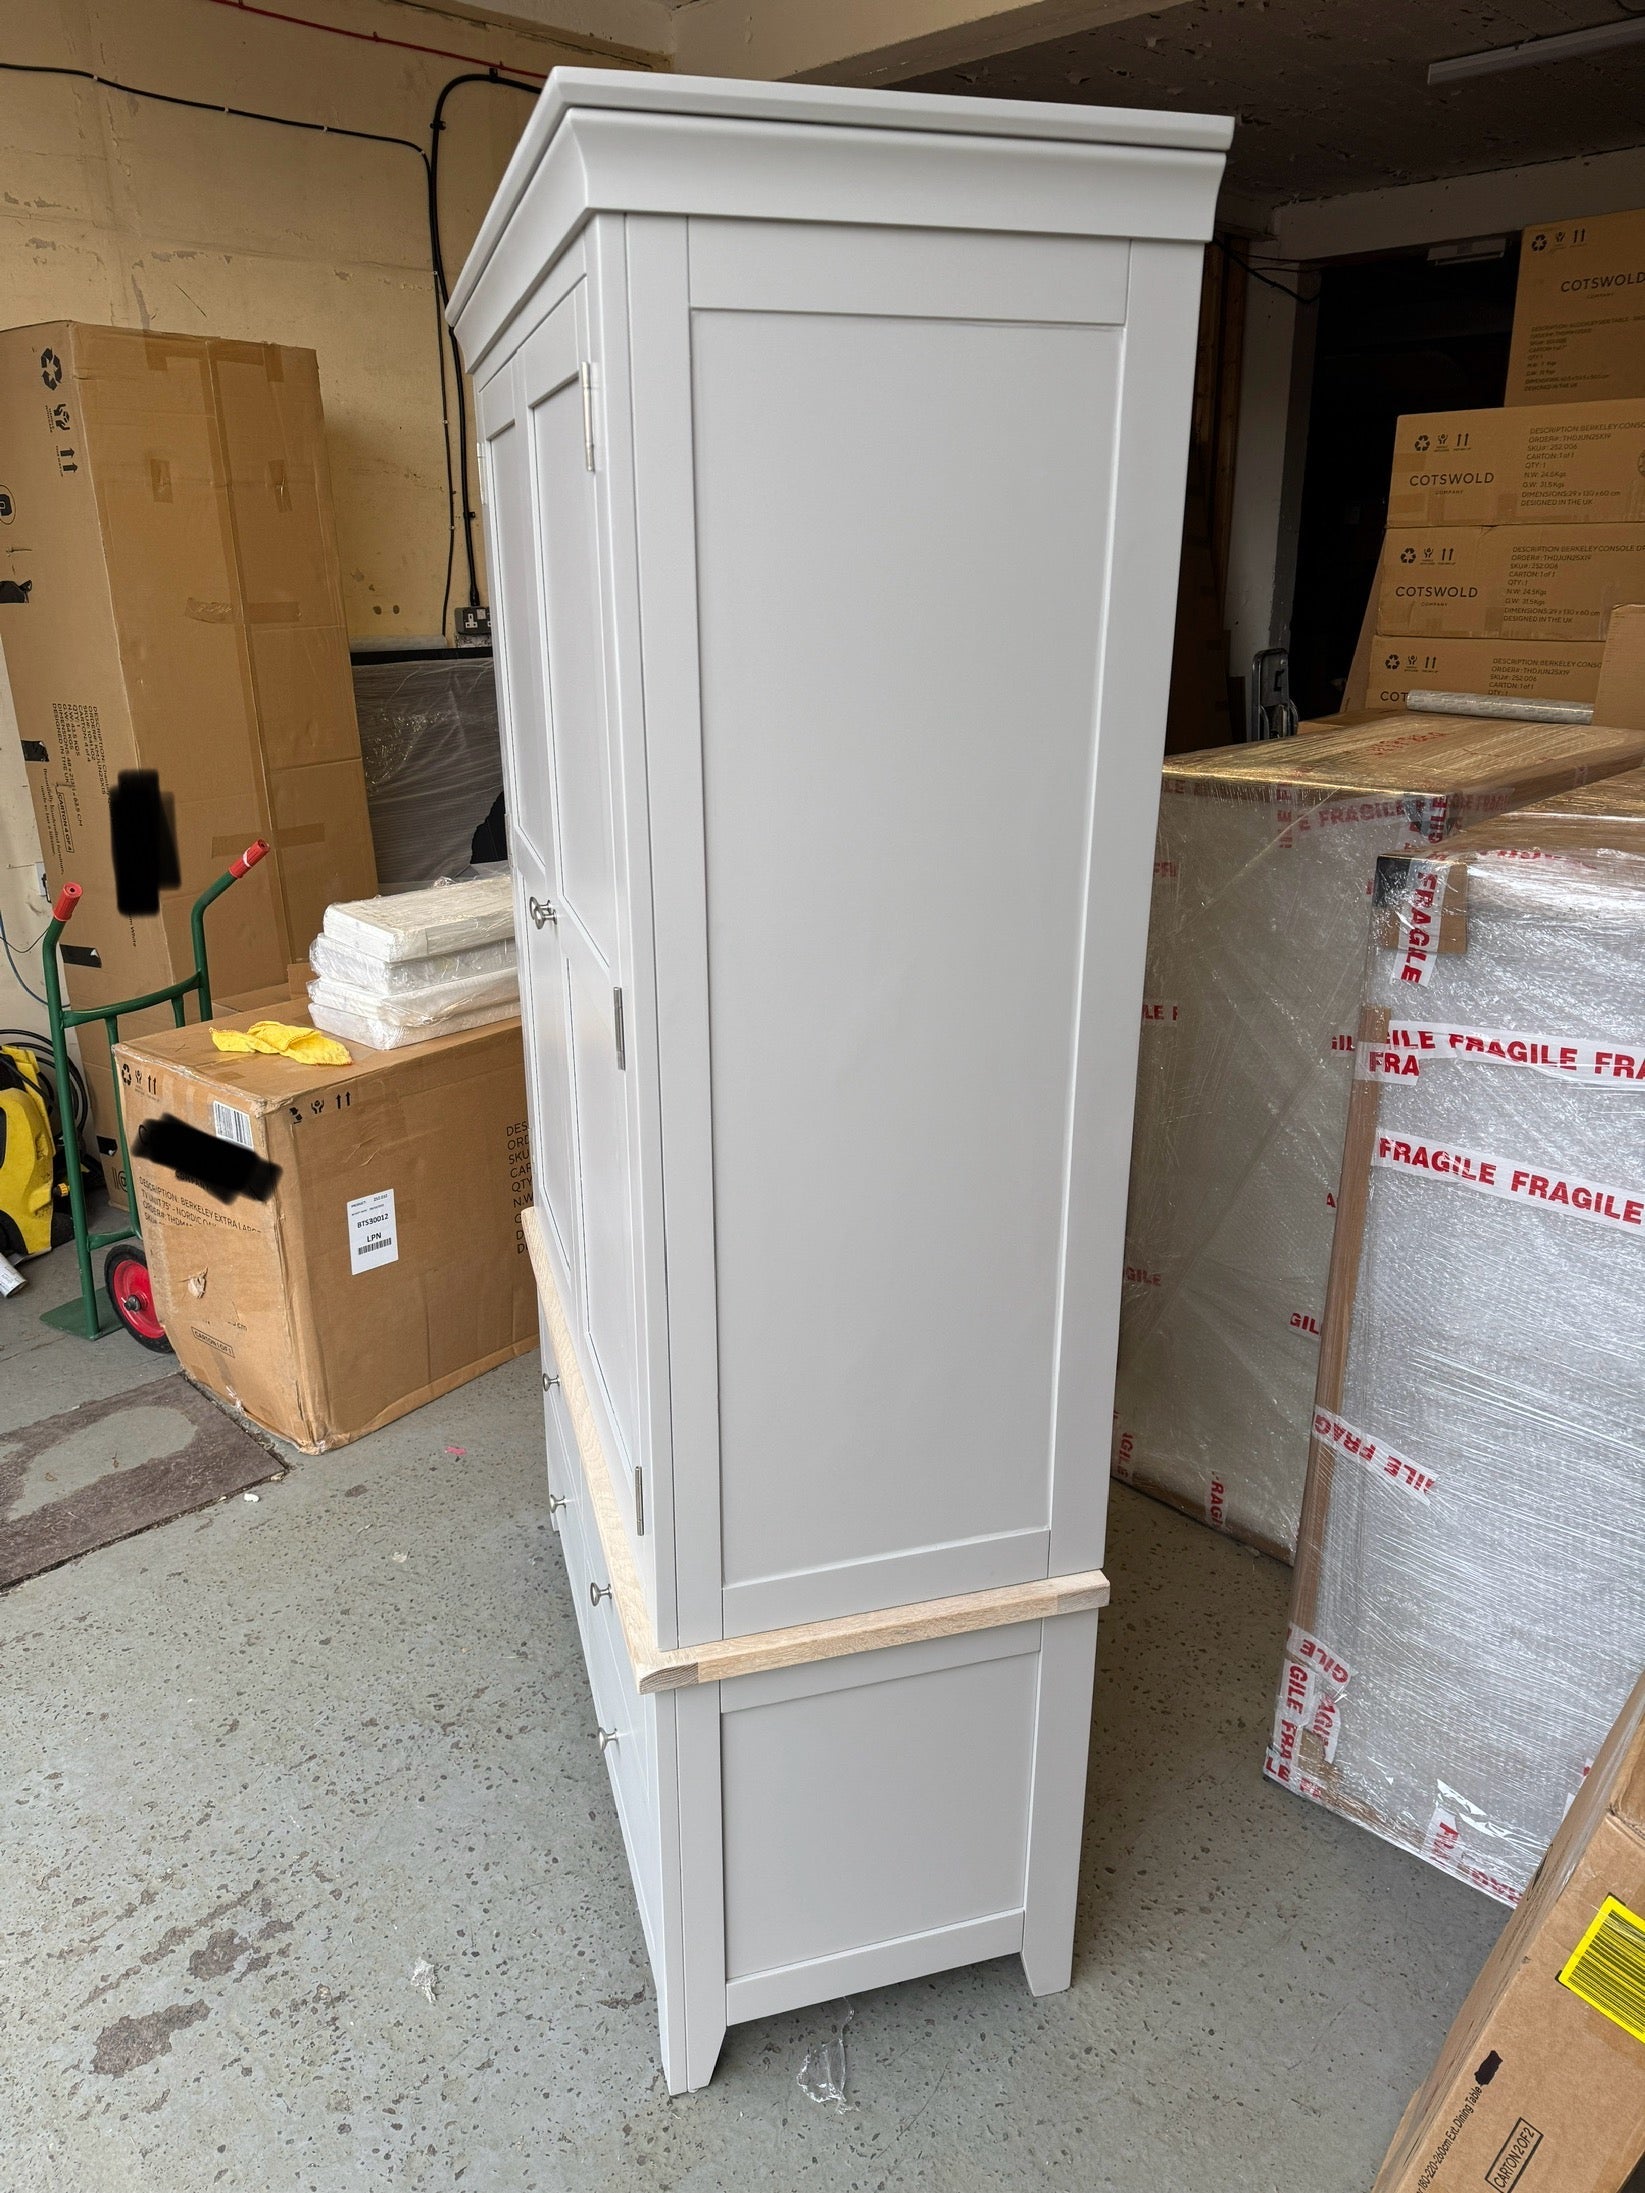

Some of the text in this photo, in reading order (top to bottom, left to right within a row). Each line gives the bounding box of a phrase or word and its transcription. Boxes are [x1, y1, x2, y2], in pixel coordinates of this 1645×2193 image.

[1560, 271, 1645, 293] COTSWOLD
[1409, 472, 1495, 487] COTSWOLD
[1395, 586, 1479, 598] COTSWOLD
[1401, 871, 1438, 984] FRAGILE
[1449, 1033, 1577, 1071] FRAGILE
[1379, 1137, 1645, 1226] FRAGILE FRAGILE
[180, 1196, 214, 1219] BERKELEY
[214, 1212, 238, 1228] EXTRA
[366, 1232, 382, 1243] LPN
[1299, 1638, 1350, 1684] GILE
[1285, 1664, 1309, 1716] GILE
[1418, 2137, 1453, 2192] 180-220-260cm
[1453, 2104, 1475, 2129] Dining
[1465, 2086, 1483, 2106] Table
[1493, 2126, 1535, 2189] CARTON 2 OF 2
